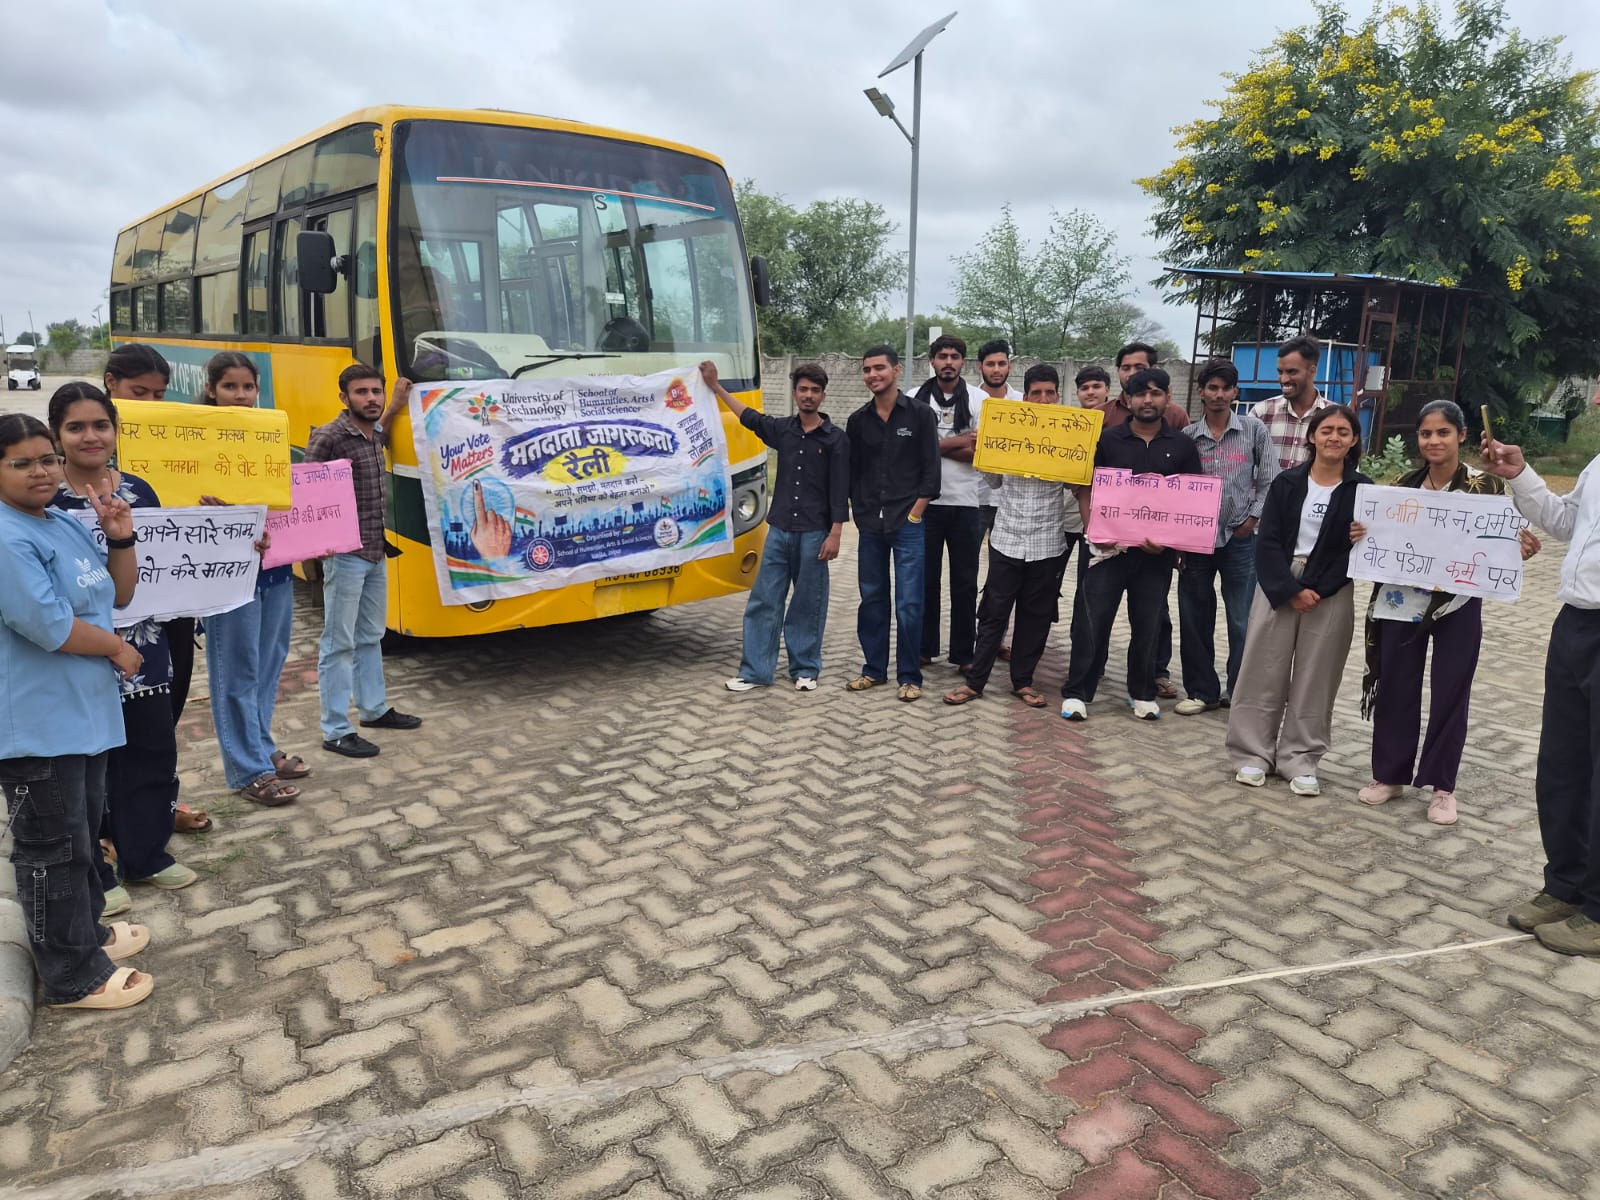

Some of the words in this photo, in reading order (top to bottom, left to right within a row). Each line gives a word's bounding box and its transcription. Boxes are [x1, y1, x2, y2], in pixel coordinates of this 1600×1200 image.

[502, 391, 550, 404] University
[553, 390, 564, 401] of
[578, 388, 607, 398] School
[608, 388, 618, 396] of
[631, 394, 649, 403] Arts
[503, 402, 567, 416] Technology
[581, 407, 606, 417] Social
[607, 405, 641, 415] Sciences
[992, 411, 1006, 423] न
[1048, 417, 1059, 429] न
[440, 442, 465, 470] Your
[466, 433, 490, 450] Vote
[509, 426, 583, 466] मतदाता
[983, 435, 1024, 453] मतदान
[1024, 437, 1036, 454] के
[128, 459, 151, 473] हर
[214, 452, 232, 476] को
[237, 454, 258, 477] वोट
[451, 445, 494, 476] Matters
[562, 448, 611, 480] रैली
[1187, 480, 1214, 493] शान
[1173, 512, 1215, 528] मतदान
[1364, 500, 1379, 521] न
[1385, 498, 1425, 525] जाति
[1426, 507, 1452, 529] पर
[1474, 507, 1514, 536] धर्म
[137, 518, 183, 543] अपने
[184, 518, 223, 545] सारे
[202, 560, 252, 578] मतदान
[1363, 536, 1391, 569] वोट
[1445, 551, 1487, 581] कर्म
[1487, 565, 1520, 592] पर
